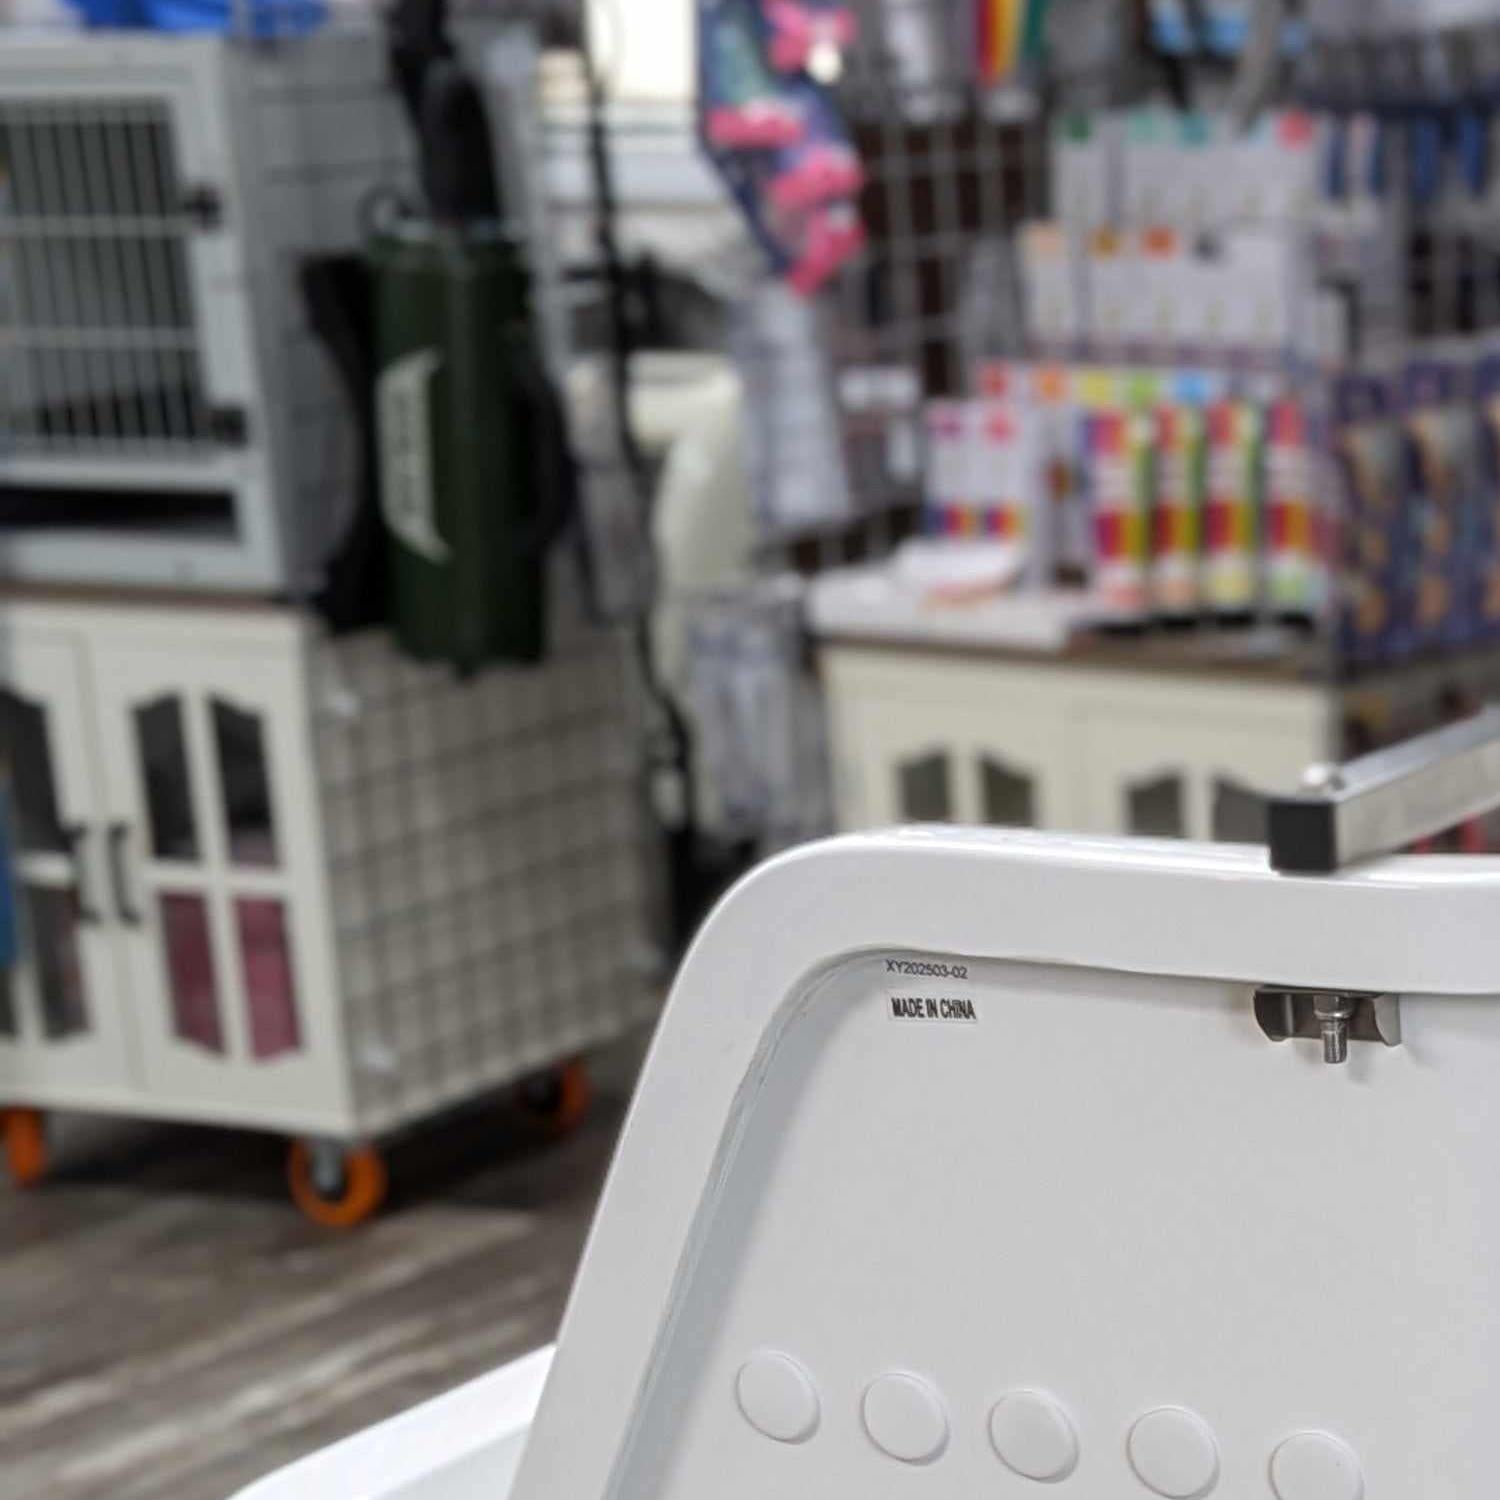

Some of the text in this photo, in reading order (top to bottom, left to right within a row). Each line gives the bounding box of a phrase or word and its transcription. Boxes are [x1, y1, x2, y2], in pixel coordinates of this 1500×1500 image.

[886, 959, 968, 979] XY202503-02
[891, 998, 977, 1020] MADE IN CHINA
